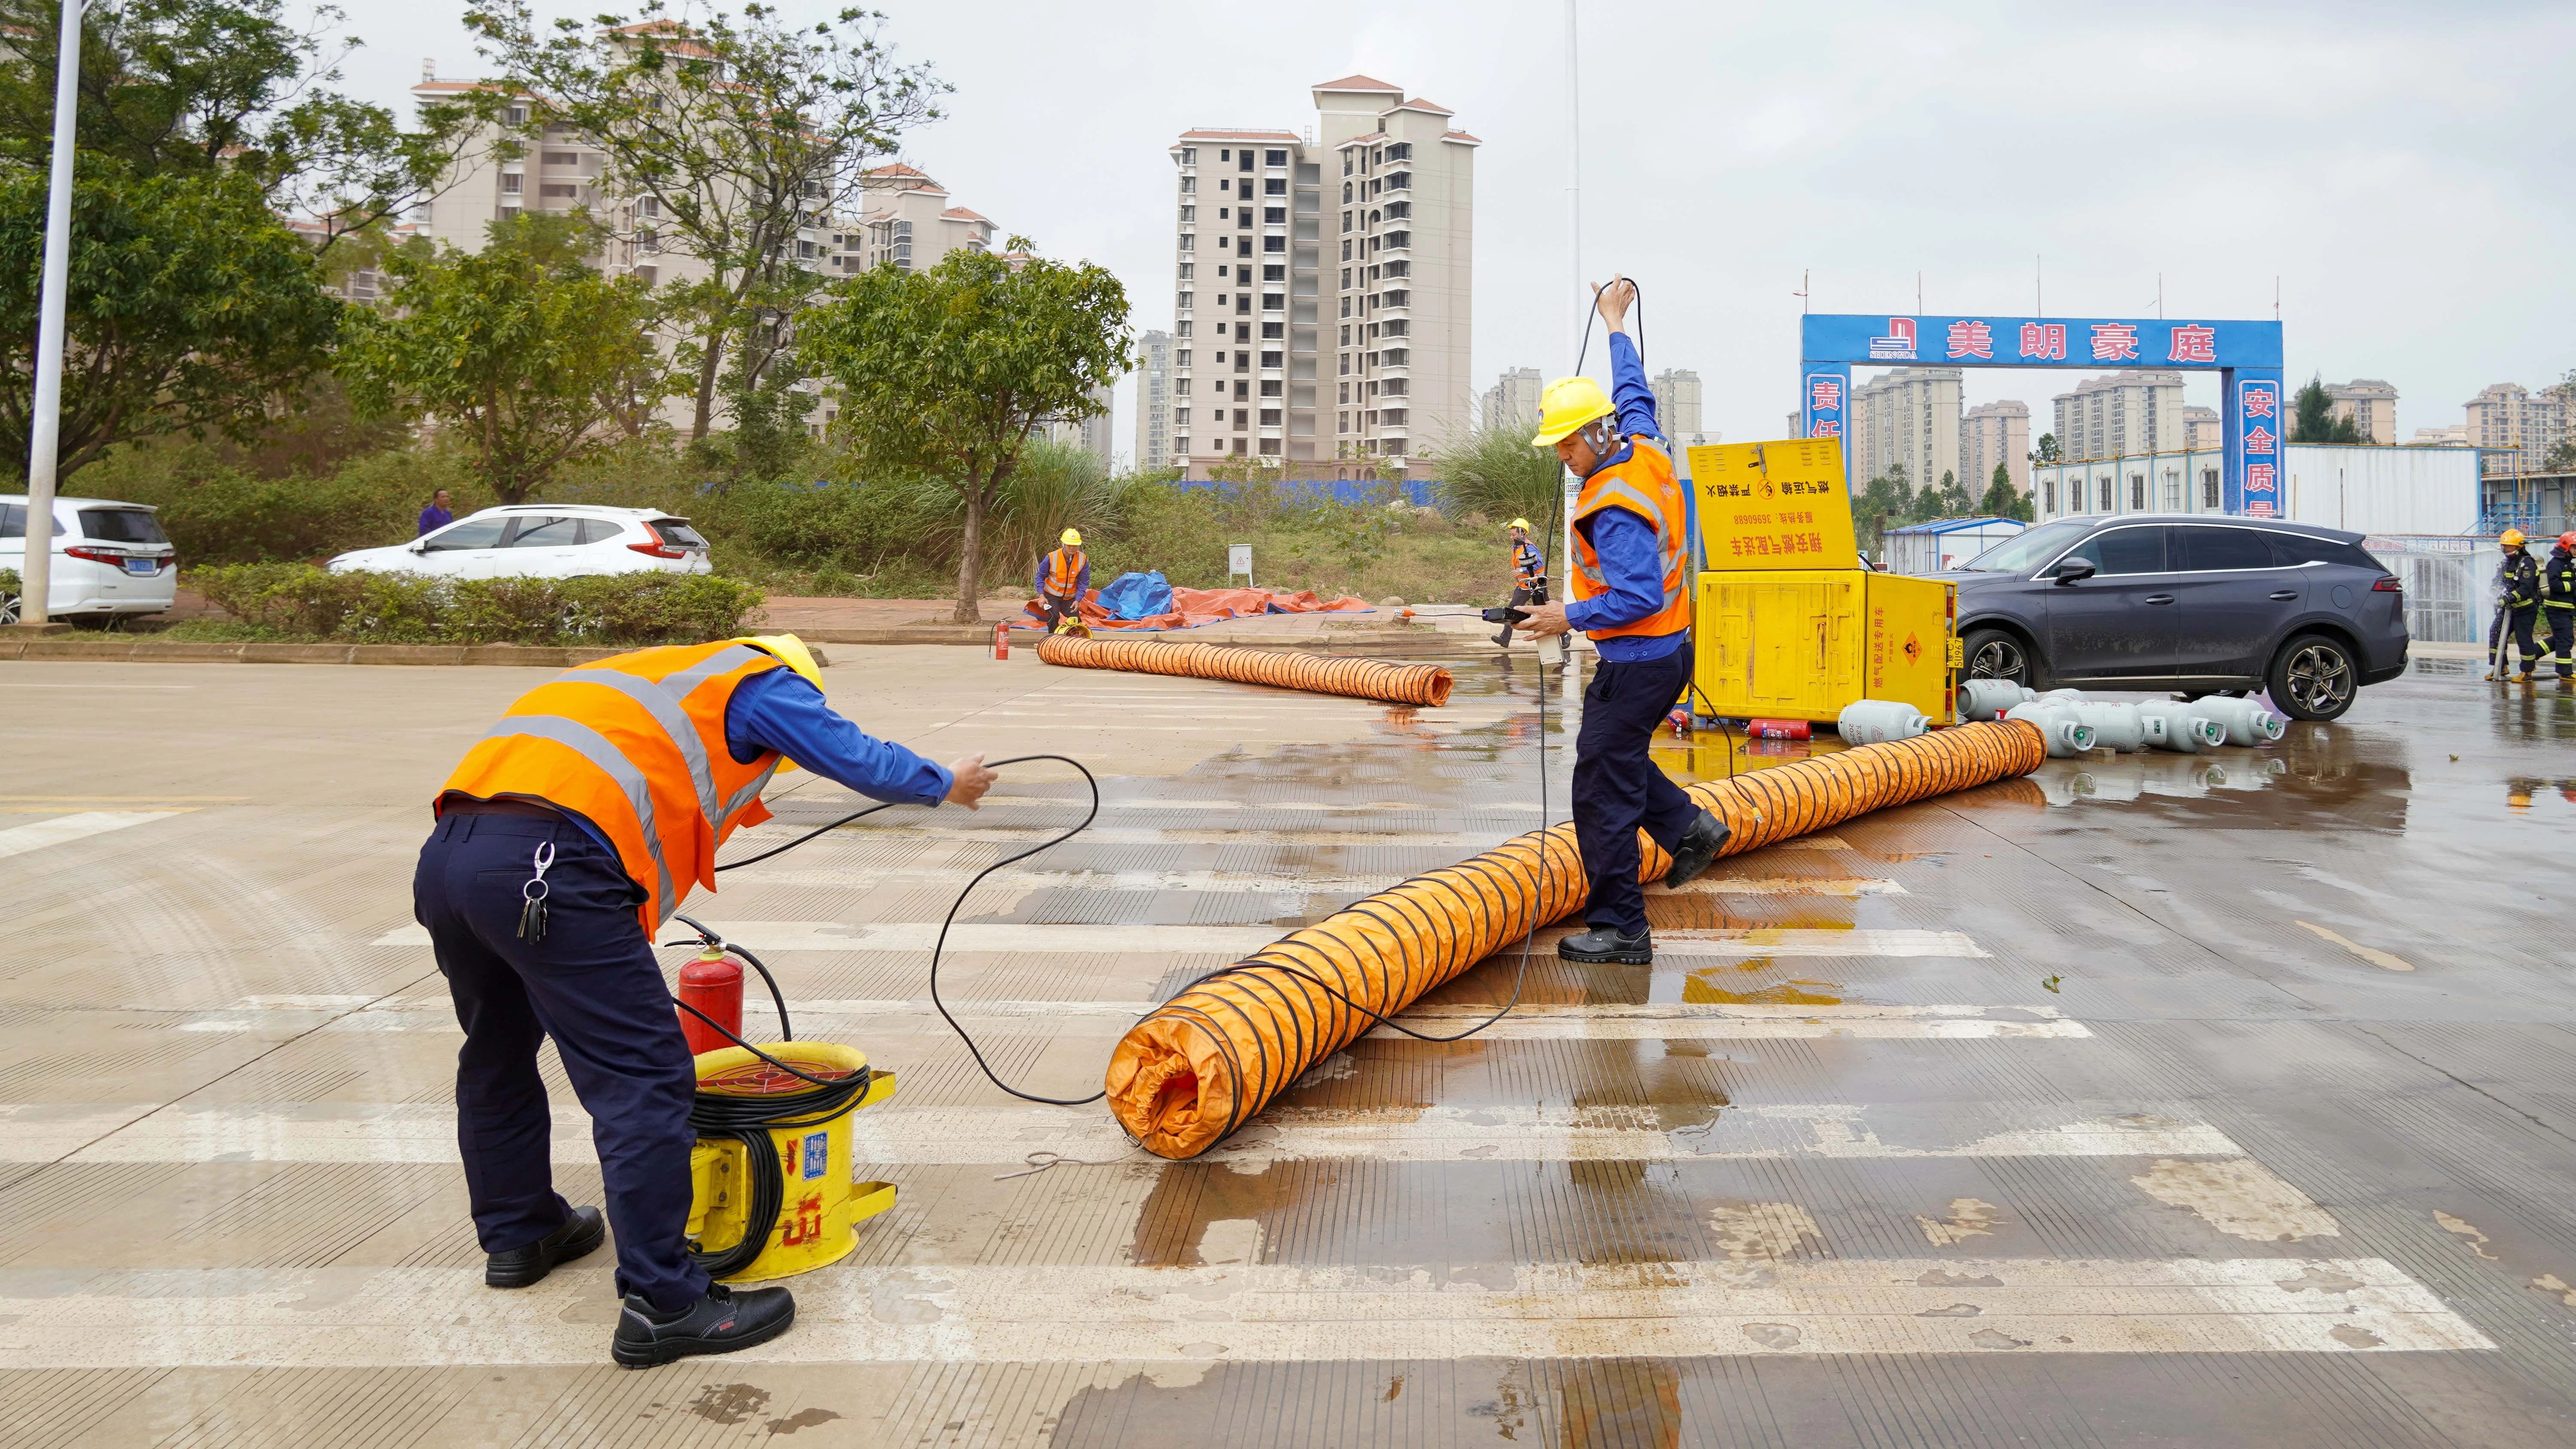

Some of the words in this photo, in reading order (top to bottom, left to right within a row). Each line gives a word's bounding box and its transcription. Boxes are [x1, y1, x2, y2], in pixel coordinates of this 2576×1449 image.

[1945, 320, 2217, 363] 美朗豪庭
[1870, 350, 1917, 360] SHENGDA
[1706, 484, 1751, 497] 严禁烟火
[1781, 481, 1829, 495] 燃气运输
[1734, 514, 1771, 524] 36960688
[1730, 532, 1823, 557] 翔安燃气配送车
[1874, 606, 1884, 688] 燃气配送专用车
